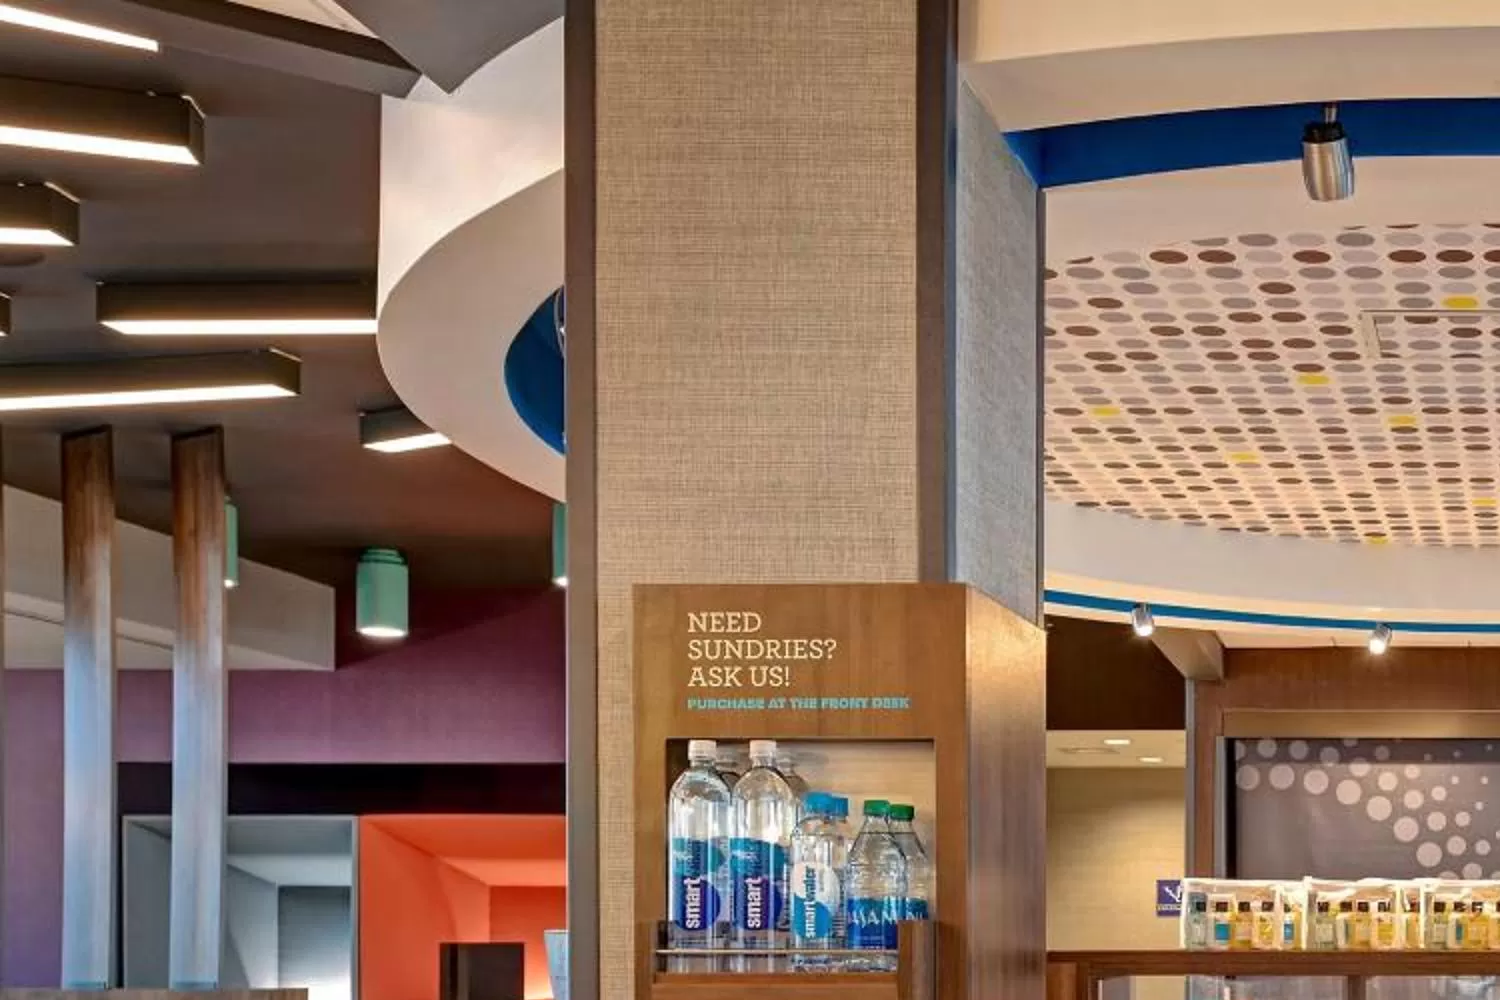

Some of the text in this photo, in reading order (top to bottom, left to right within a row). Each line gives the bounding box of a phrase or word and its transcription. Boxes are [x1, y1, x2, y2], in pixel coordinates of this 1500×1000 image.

[688, 612, 762, 633] NEED
[688, 638, 837, 660] SUNDRIES?
[688, 665, 790, 687] ASK US!
[688, 698, 765, 710] PURCHASE
[768, 698, 786, 710] AT
[791, 698, 817, 710] THE
[821, 698, 869, 710] FRONT
